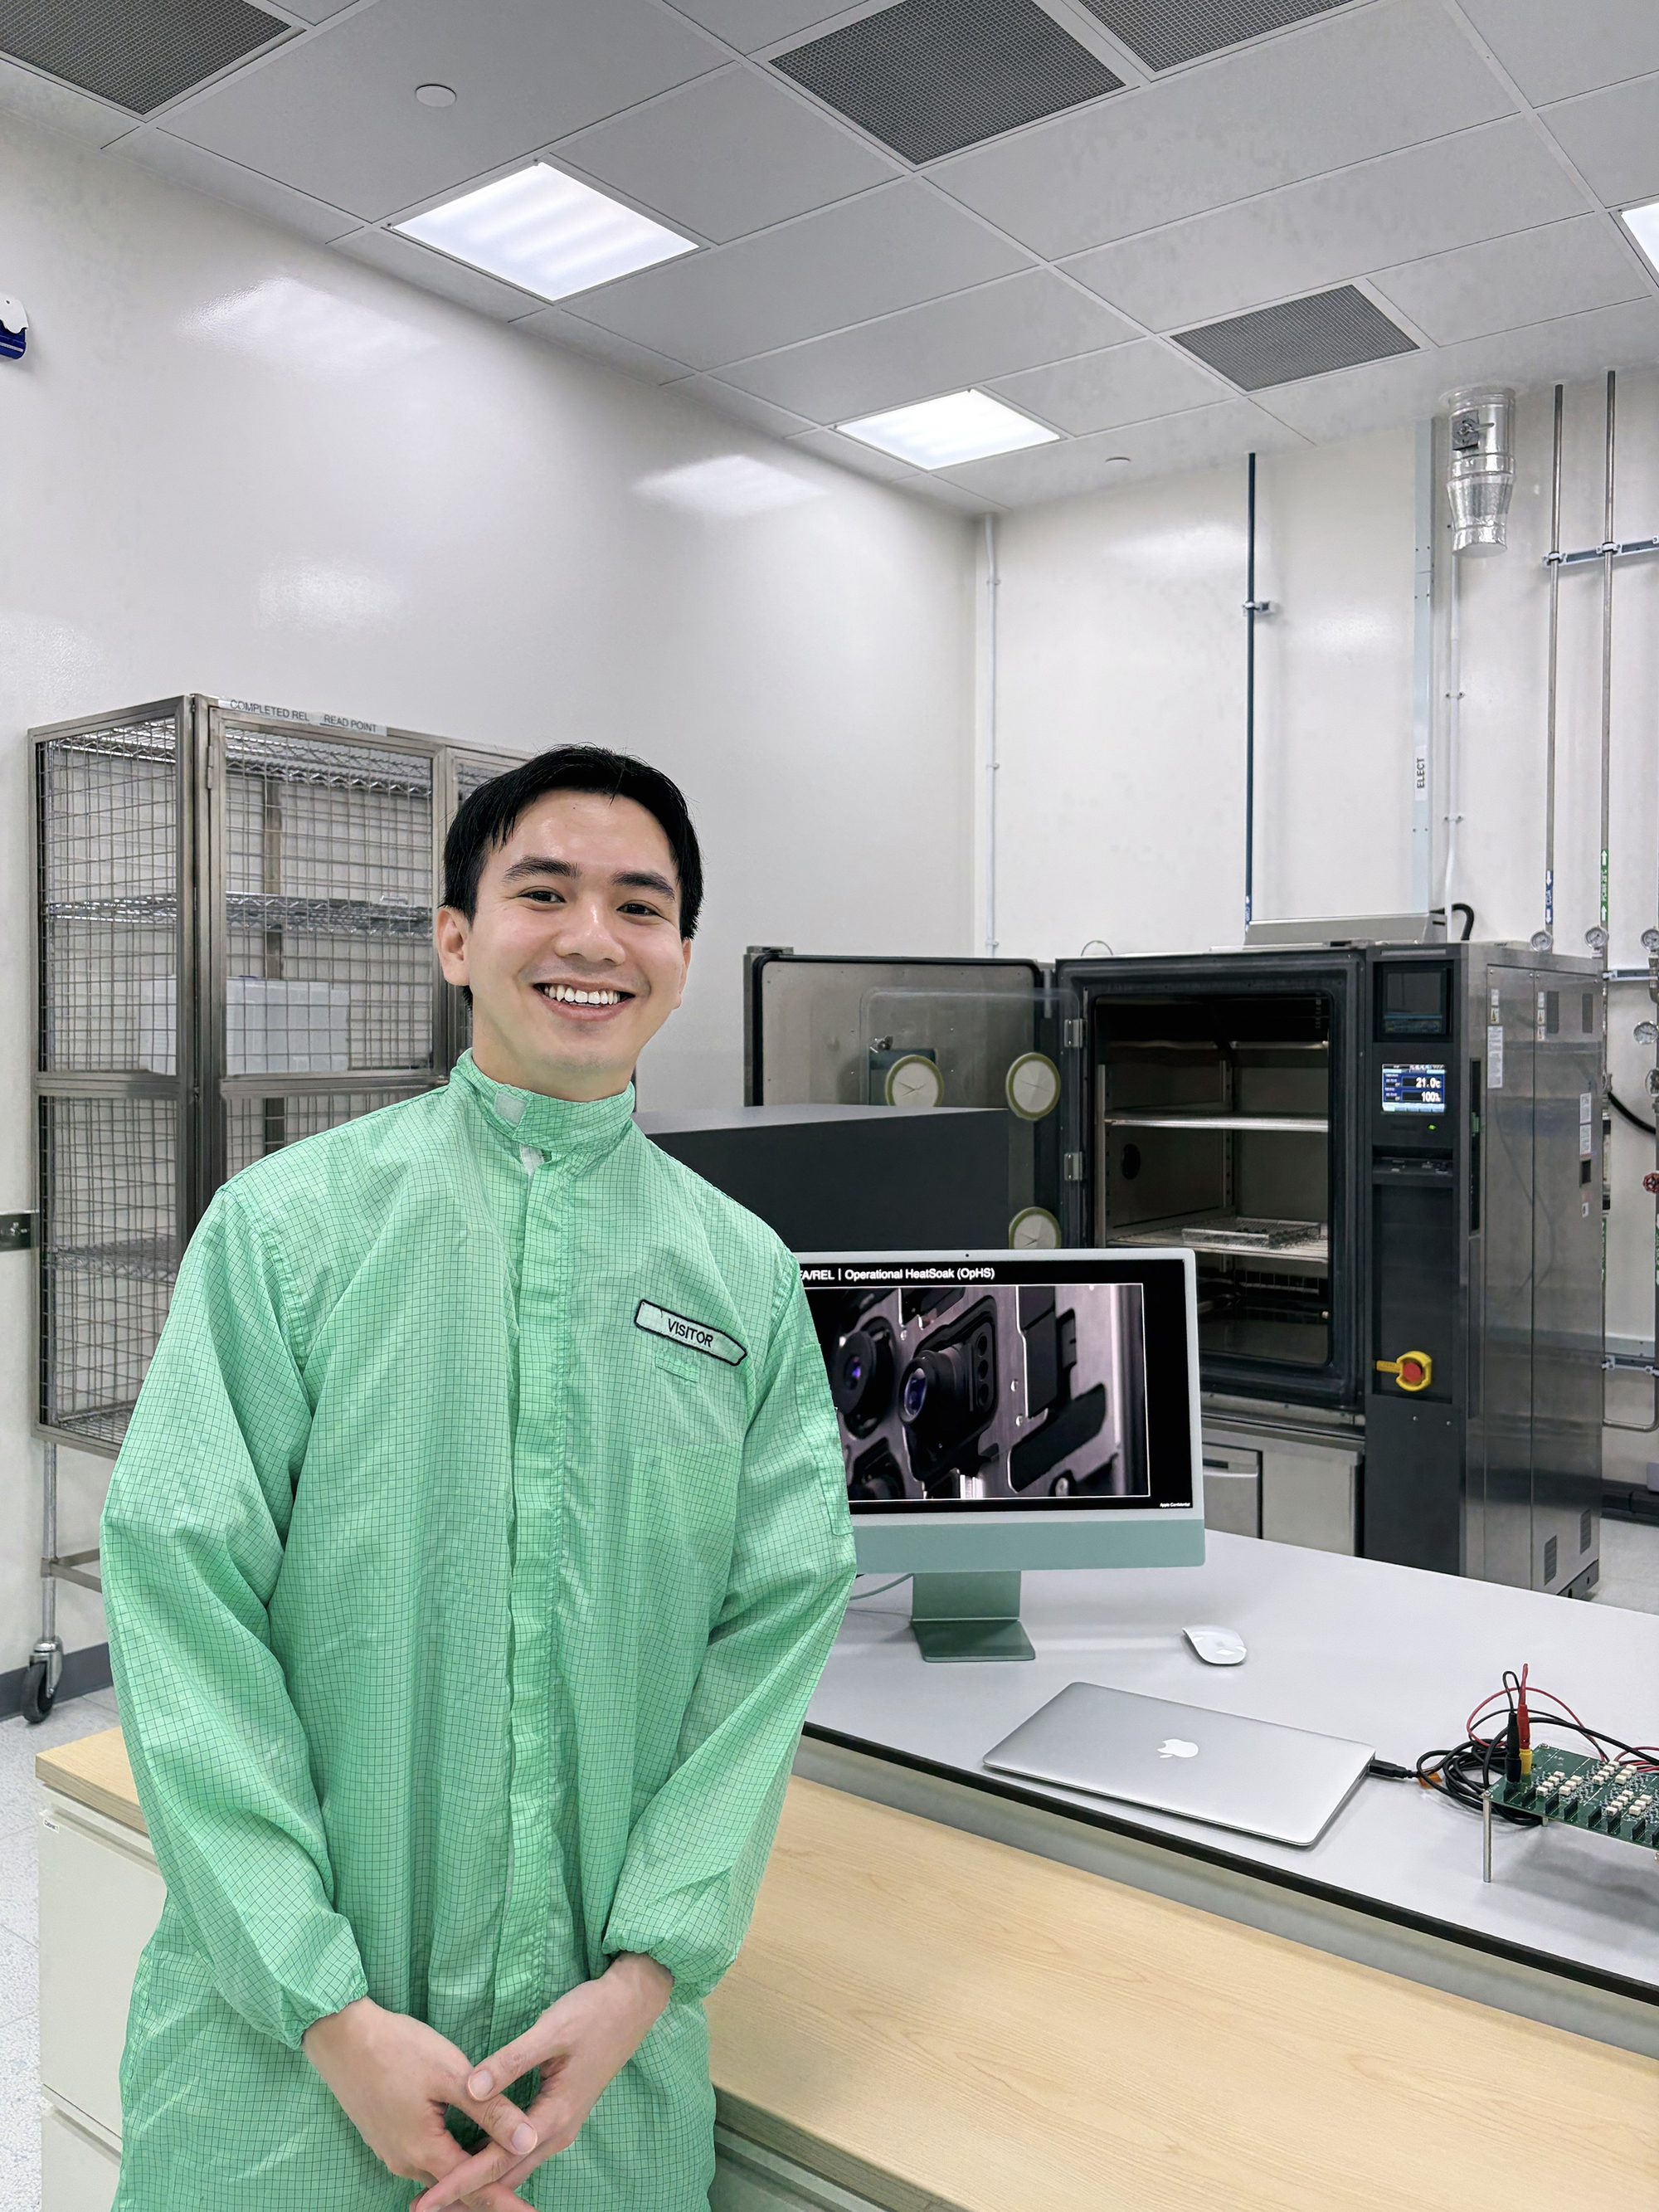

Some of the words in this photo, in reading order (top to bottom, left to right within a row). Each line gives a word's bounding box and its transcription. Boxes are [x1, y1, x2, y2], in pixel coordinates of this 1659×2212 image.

[230, 699, 290, 719] COMPLETED
[292, 710, 310, 721] REL
[324, 714, 349, 726] READ
[350, 720, 377, 733] POINT
[1416, 758, 1425, 788] ELECT
[844, 1269, 902, 1282] Operational
[905, 1268, 955, 1279] HeatSoak
[956, 1268, 995, 1281] (OpHS)
[668, 1318, 713, 1347] VISITOR
